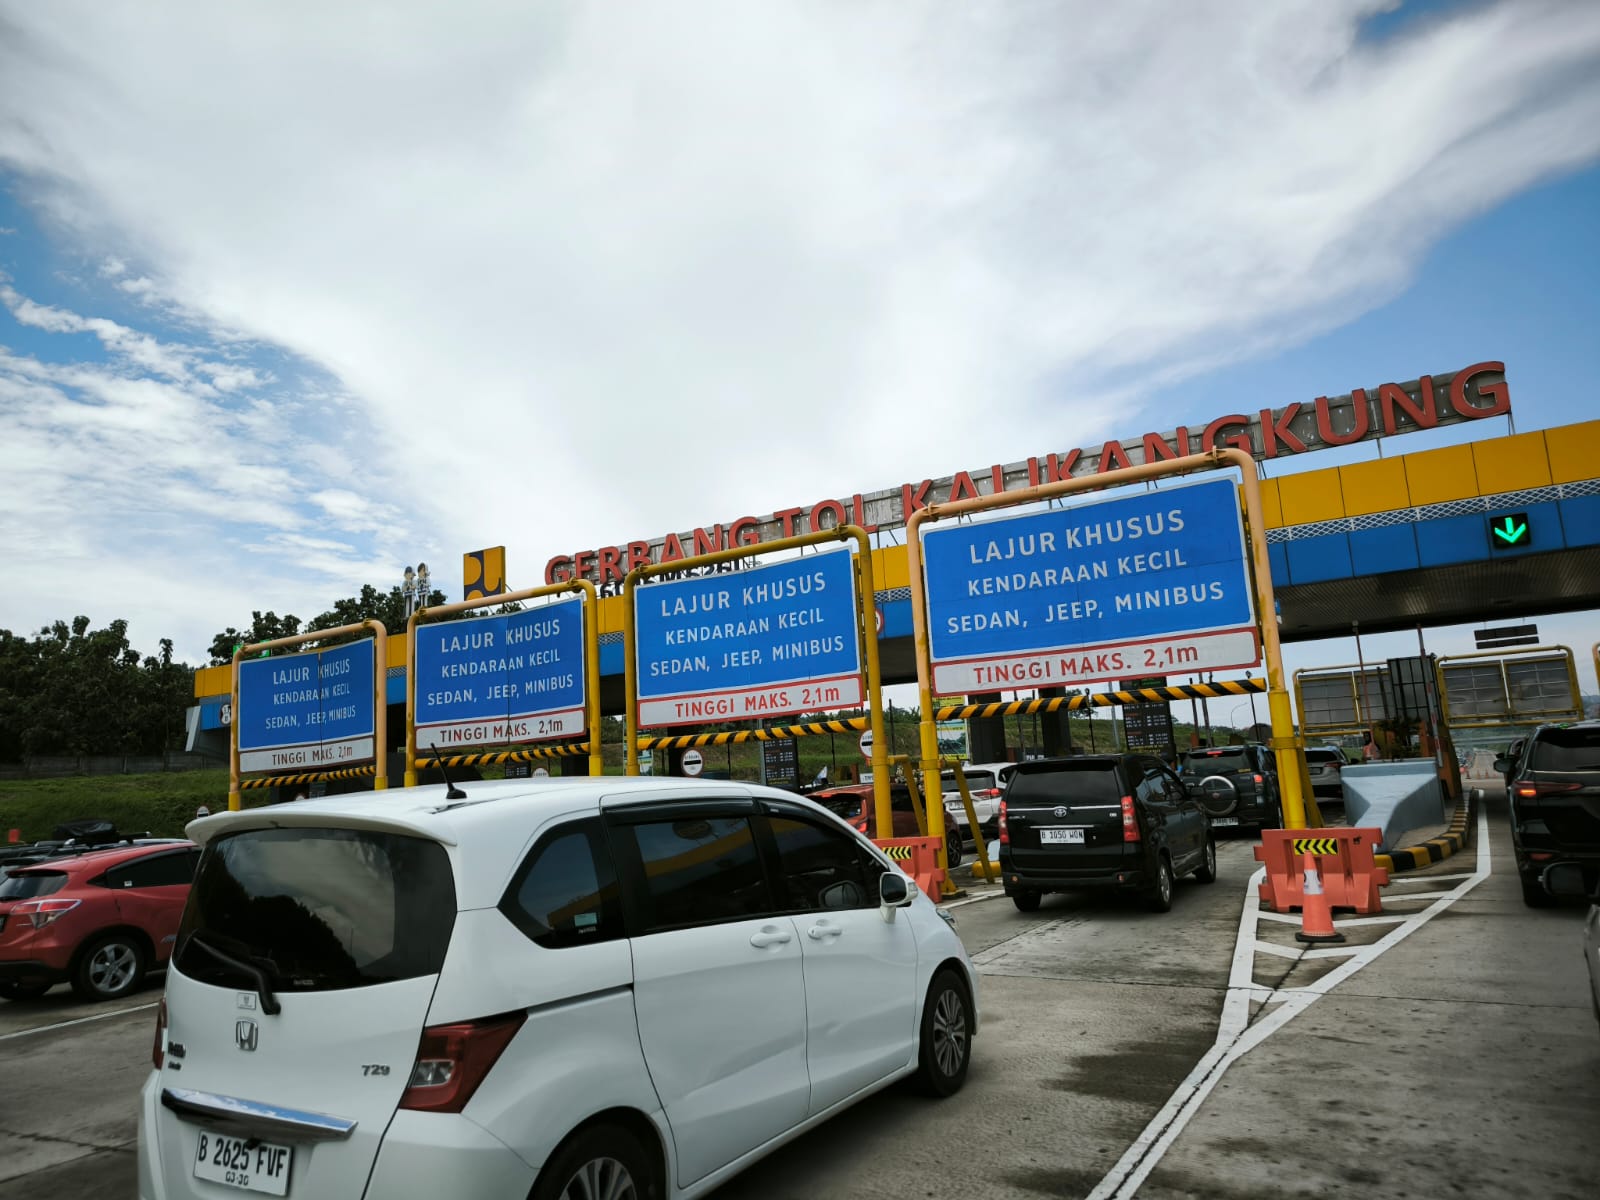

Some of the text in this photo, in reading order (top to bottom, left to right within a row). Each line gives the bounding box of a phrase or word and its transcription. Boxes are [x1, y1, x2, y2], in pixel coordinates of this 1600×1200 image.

[545, 516, 763, 586] GERBANG
[773, 494, 878, 538] TOL
[970, 510, 1185, 564] LAJUR KHUSUS
[968, 549, 1187, 597] KENDARAAN KECIL
[661, 591, 730, 617] LAJUR
[743, 572, 826, 606] KHUSUS
[947, 582, 1224, 634] SEDAN, JEEP, MINIBUS
[441, 619, 560, 653] LAJUR KHUSUS
[665, 608, 824, 645] KENDARAAN KECIL
[273, 659, 350, 685] LAJUR KHUSUS
[441, 649, 561, 678] KENDARAAN KECIL
[650, 636, 844, 677] SEDAN, JEEP, MINIBUS
[973, 646, 1198, 684] TINGGI MAKS. 2,1m
[273, 683, 350, 705] KENDARAAN KECIL
[427, 674, 573, 706] SEDAN, JEEP, MINIBUS
[675, 687, 840, 718] TINGGI MAKS. 2,1m
[265, 705, 356, 730] SEDAN, JEEP, MINIBUS
[440, 719, 563, 743] TINGGI MAKS. 2,1m
[272, 751, 306, 765] TINGGI
[312, 747, 335, 762] MAKS.
[362, 1064, 390, 1076] 729
[198, 1134, 287, 1178] B 2625 FVF
